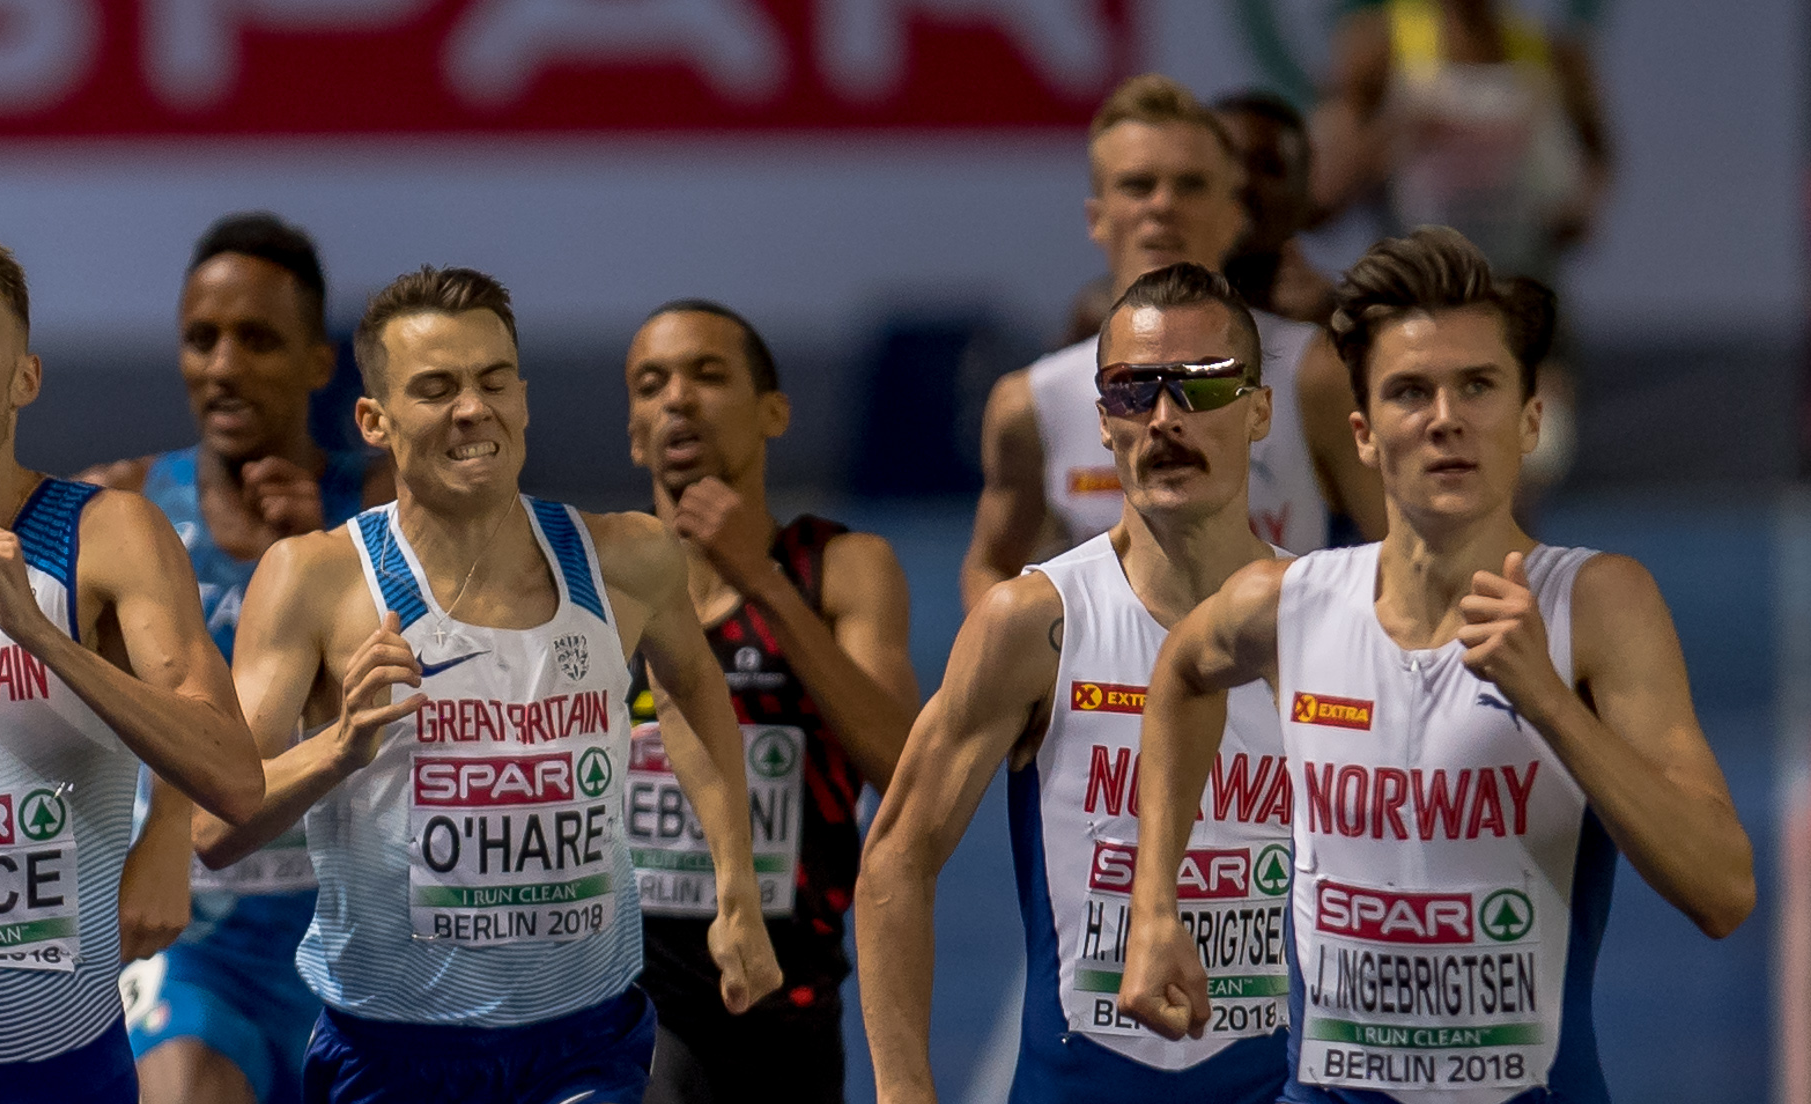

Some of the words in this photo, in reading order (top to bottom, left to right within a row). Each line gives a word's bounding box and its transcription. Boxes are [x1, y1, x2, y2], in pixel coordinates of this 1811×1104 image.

[417, 698, 506, 742] GREAT
[507, 689, 609, 744] BRITAIN
[1319, 703, 1369, 722] EXTRA
[419, 760, 570, 799] SPAR
[1304, 760, 1540, 841] NORWAY
[422, 804, 606, 875] O'HARE
[1094, 848, 1247, 891] SAR
[462, 889, 468, 905] I
[474, 888, 513, 905] RUN
[1320, 887, 1470, 938] SPAR
[434, 911, 536, 940] BERLIN
[548, 903, 603, 936] 2018
[1082, 900, 1105, 961] H.
[1310, 944, 1329, 1007] J.
[1336, 948, 1536, 1016] INGEBRIGTSEN
[1213, 1001, 1277, 1031] 2018
[1365, 1026, 1409, 1044] RUN
[1324, 1048, 1435, 1083] BERLIN
[1447, 1053, 1525, 1083] 2018
